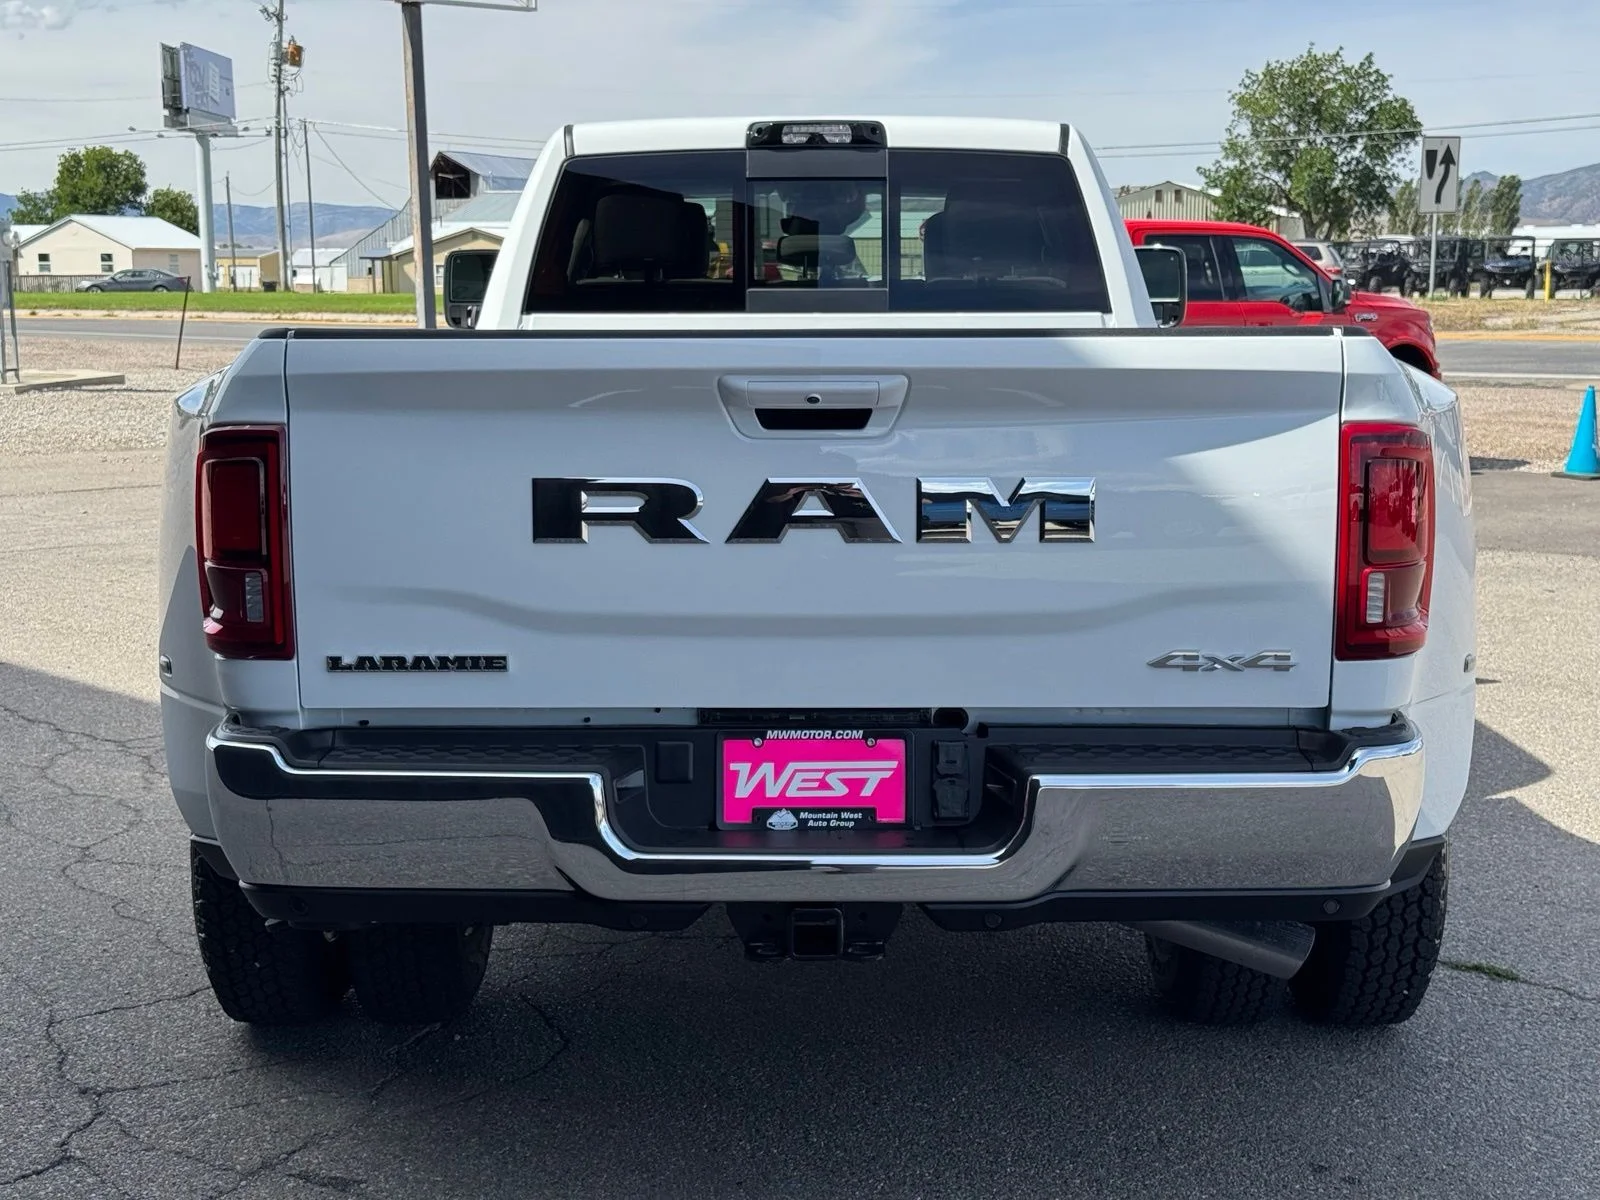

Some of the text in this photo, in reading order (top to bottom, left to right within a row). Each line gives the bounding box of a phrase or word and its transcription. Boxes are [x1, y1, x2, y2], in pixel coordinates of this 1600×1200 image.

[532, 477, 1096, 543] RAM
[326, 655, 509, 672] LARAMIE
[766, 729, 864, 740] MWMOTOR.COM
[729, 761, 899, 798] WEST
[799, 811, 863, 819] Mountain West
[807, 819, 828, 828] Auto
[829, 819, 855, 828] Group
